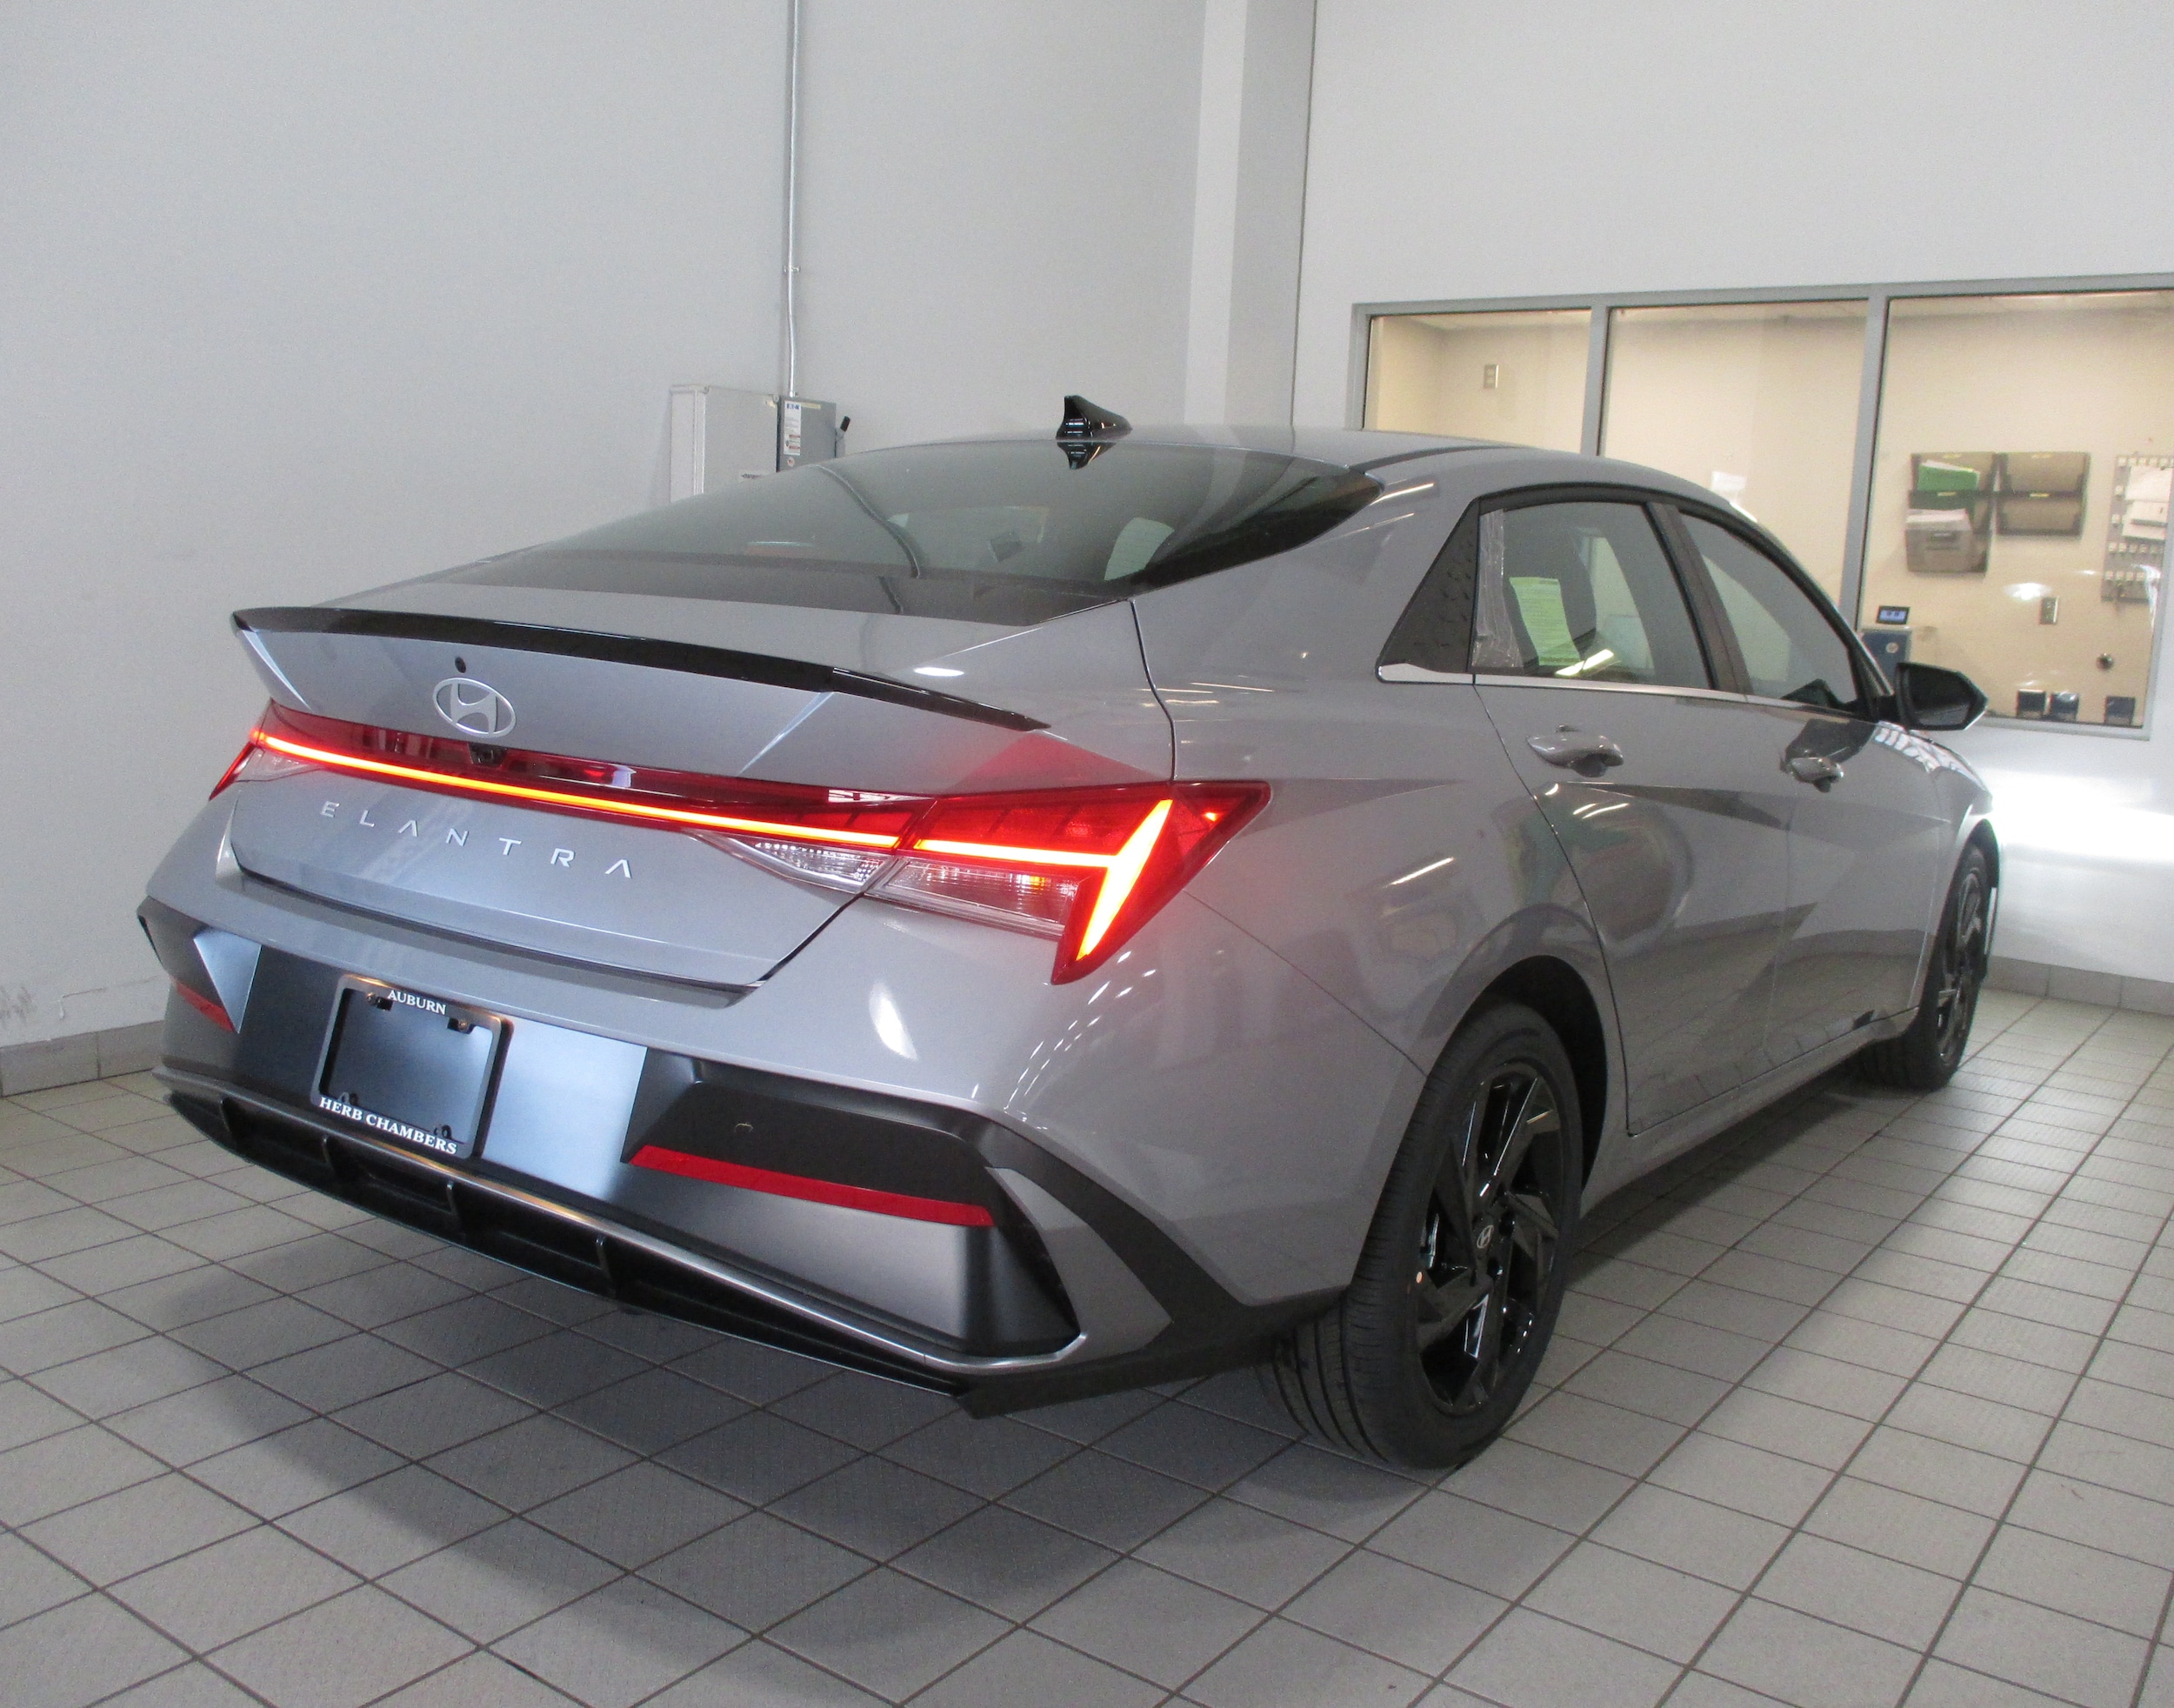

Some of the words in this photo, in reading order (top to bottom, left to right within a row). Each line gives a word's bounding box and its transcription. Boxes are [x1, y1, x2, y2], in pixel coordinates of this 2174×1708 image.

[320, 800, 632, 878] ELANTRA
[388, 990, 446, 1015] AUBURN
[319, 1097, 363, 1121] HERB
[365, 1114, 457, 1155] CHAMBERS
